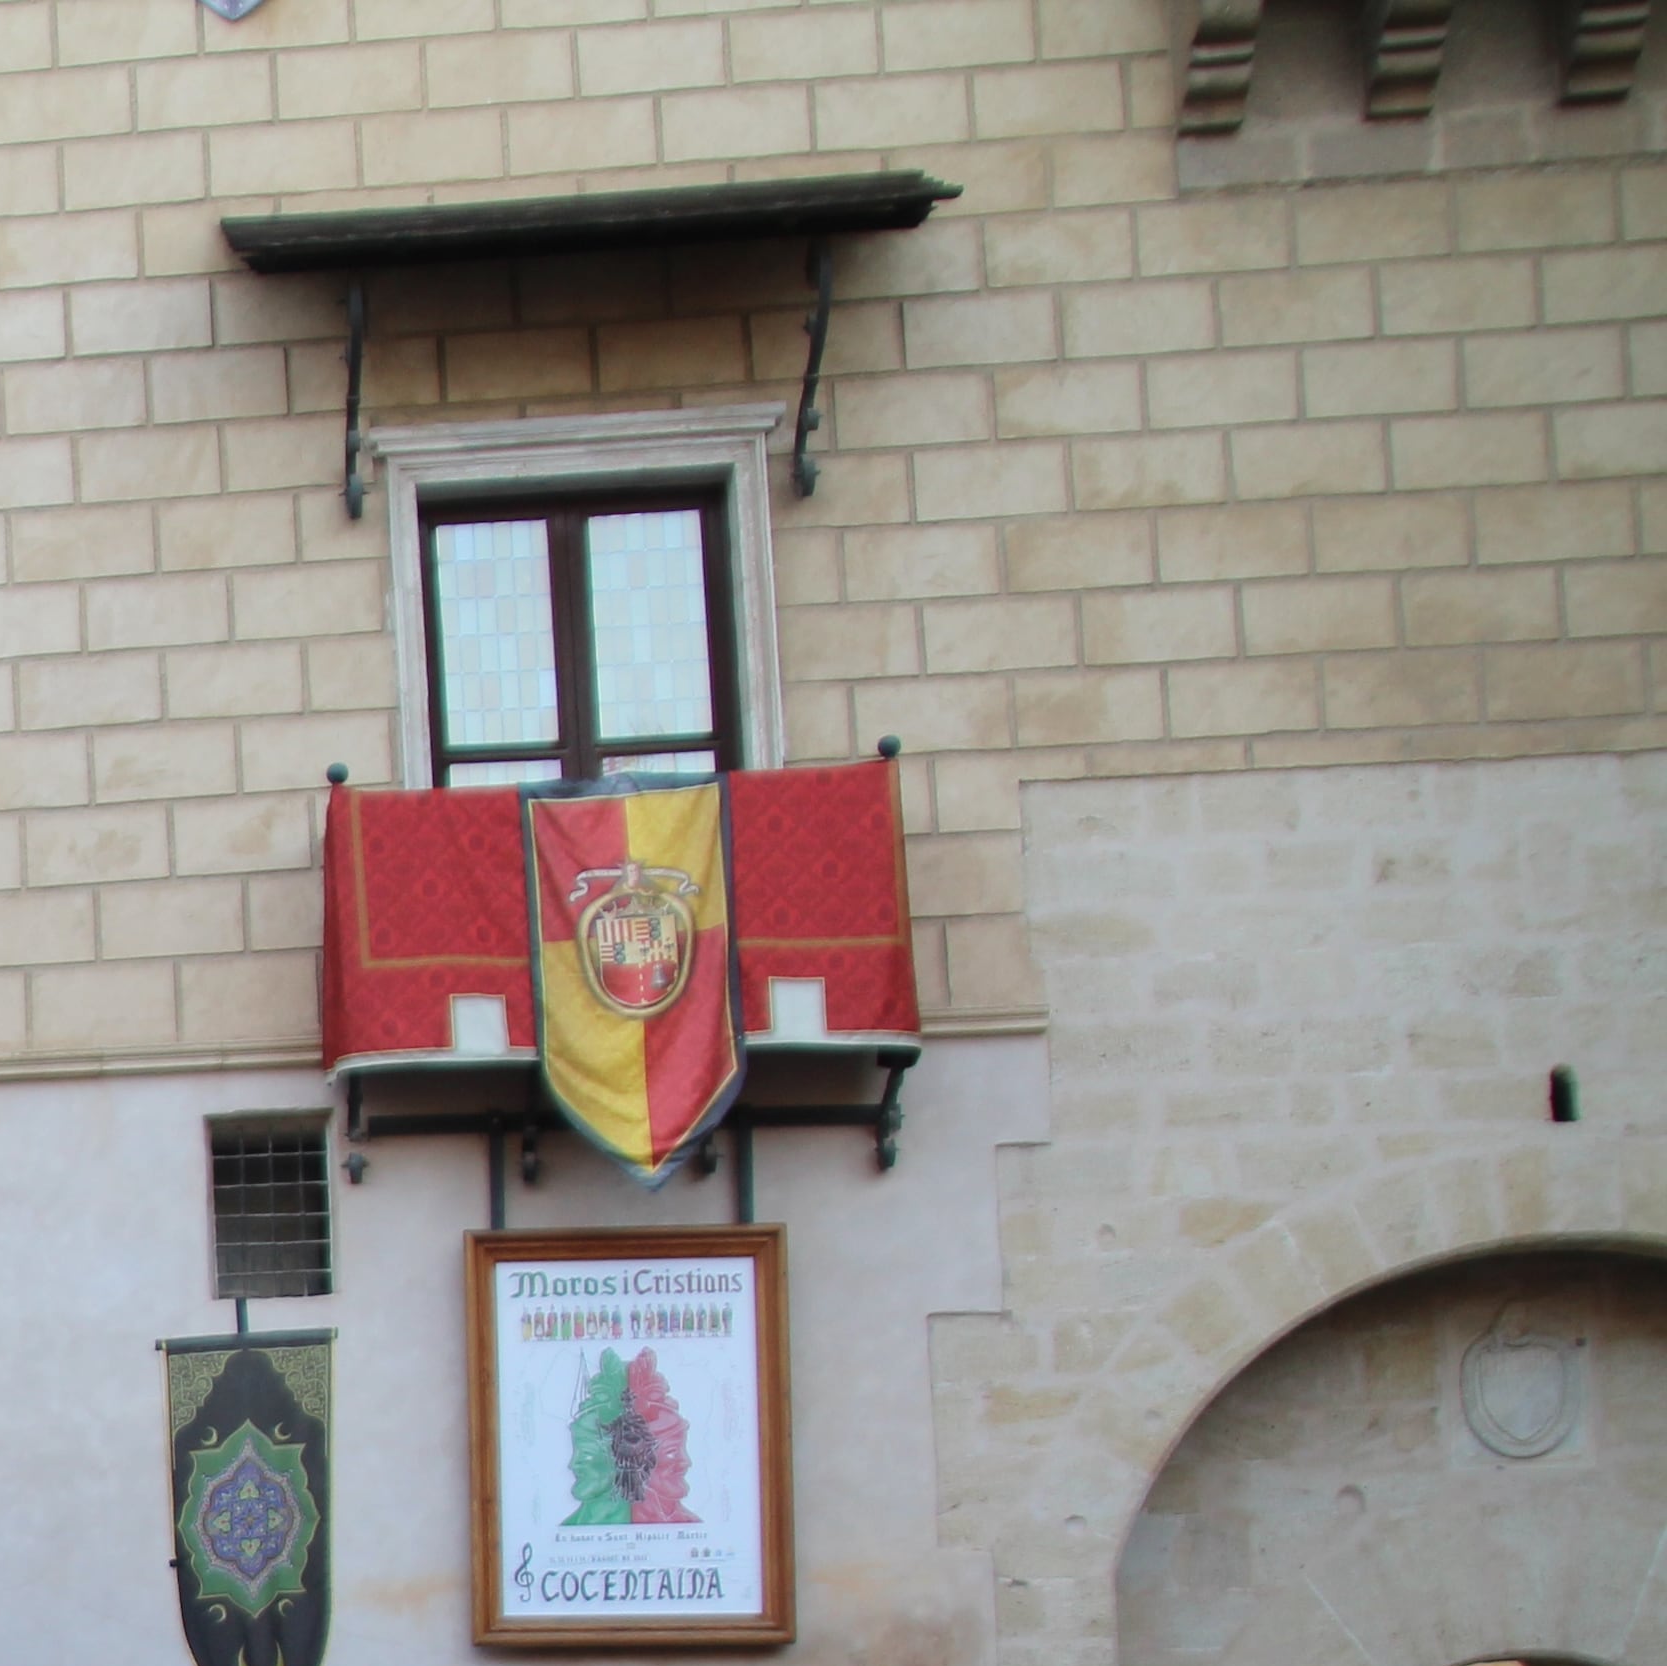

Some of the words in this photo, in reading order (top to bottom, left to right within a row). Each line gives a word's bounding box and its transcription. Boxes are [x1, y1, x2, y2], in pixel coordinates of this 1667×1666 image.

[508, 1270, 617, 1299] Moros
[622, 1270, 630, 1295] i
[633, 1268, 744, 1295] Cristians
[540, 1566, 725, 1602] COCENTAINA
